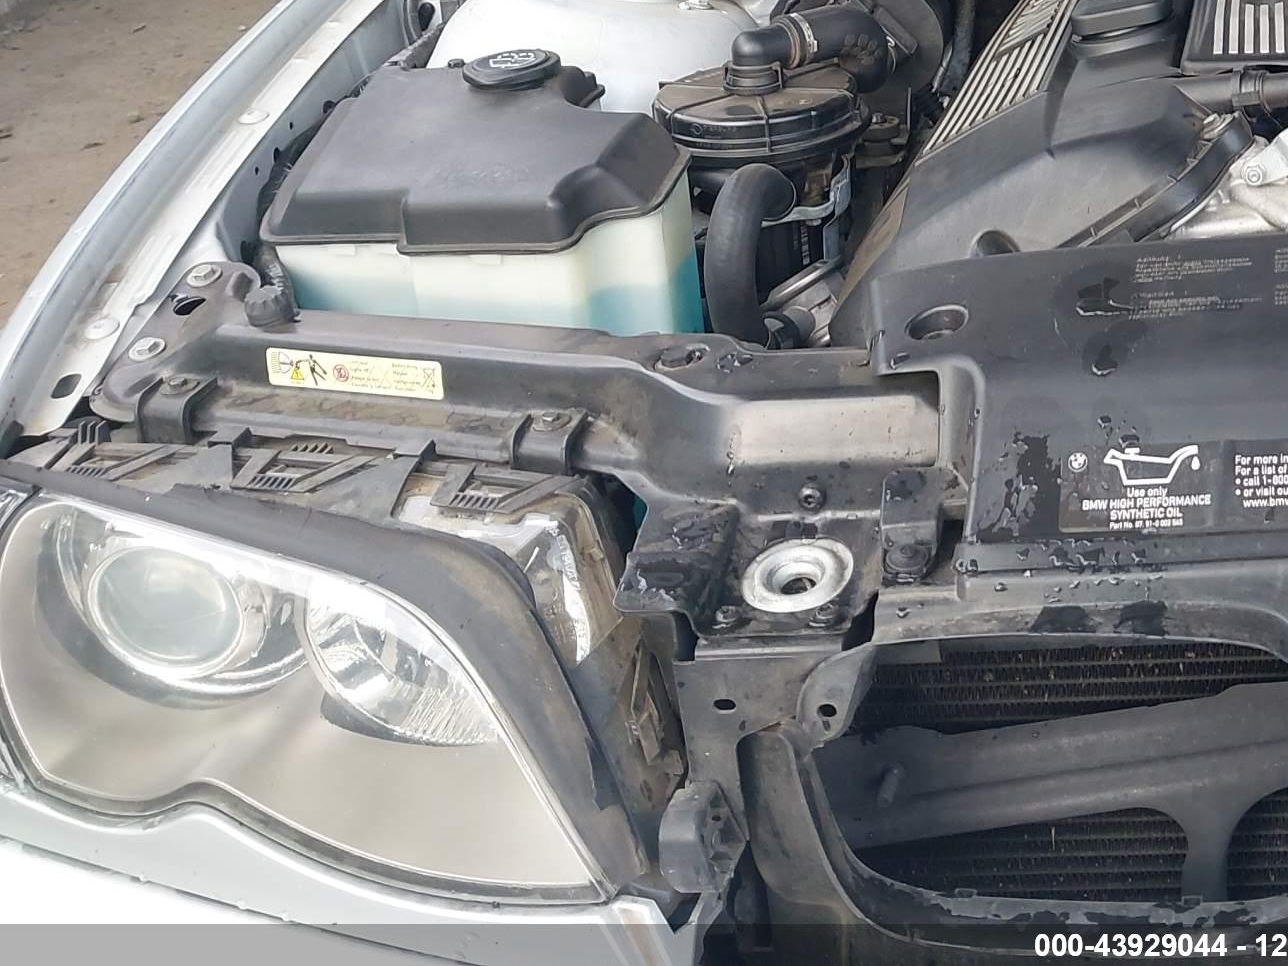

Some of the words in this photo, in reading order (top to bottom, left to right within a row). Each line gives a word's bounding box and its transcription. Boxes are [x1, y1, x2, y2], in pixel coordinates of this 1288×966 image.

[1235, 454, 1251, 465] For
[1253, 455, 1278, 465] more
[1235, 465, 1251, 476] For
[1253, 466, 1259, 475] a
[1261, 463, 1276, 475] list
[1277, 463, 1288, 474] of
[1243, 476, 1260, 486] call
[1127, 487, 1145, 497] Use
[1147, 485, 1168, 498] only
[1243, 487, 1254, 497] or
[1255, 484, 1276, 496] visit
[1082, 499, 1108, 511] BMW
[1110, 497, 1136, 509] HIGH
[1137, 494, 1211, 508] PERFORMANCE
[1110, 507, 1166, 520] SYNTHETIC
[1167, 507, 1183, 518] OIL
[1109, 521, 1122, 530] Part
